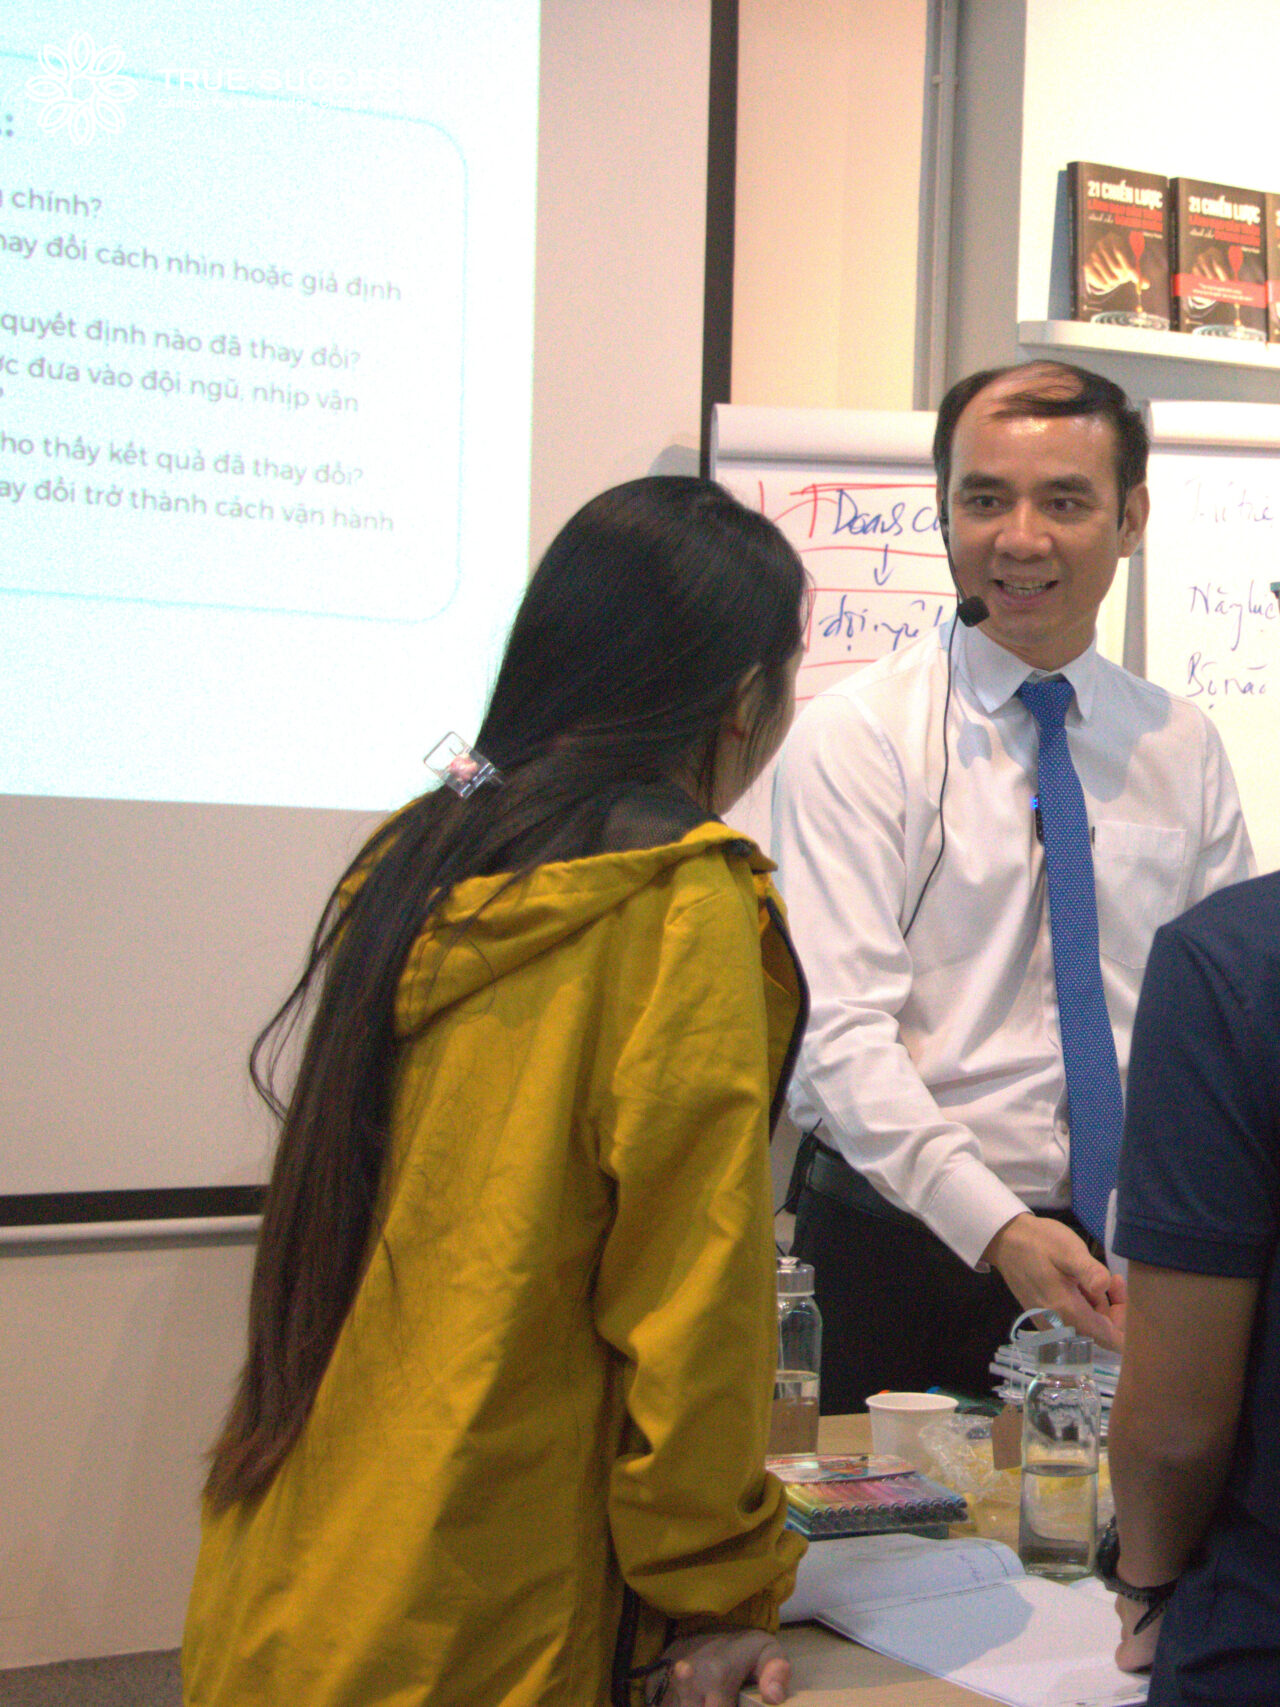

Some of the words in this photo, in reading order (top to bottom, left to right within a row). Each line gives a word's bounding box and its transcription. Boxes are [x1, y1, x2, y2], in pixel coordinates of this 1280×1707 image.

[10, 187, 103, 218] chính?
[1087, 180, 1100, 198] 21
[1188, 195, 1201, 213] 21
[45, 233, 88, 261] đổi
[95, 243, 159, 270] cách
[85, 318, 147, 347] định
[155, 328, 204, 352] nào
[249, 337, 305, 369] thay
[27, 355, 81, 382] đưa
[88, 363, 134, 388] vào
[42, 435, 101, 467] thấy
[109, 440, 149, 467] kết
[252, 457, 308, 486] thay
[34, 475, 76, 504] đổi
[214, 495, 275, 521] cách
